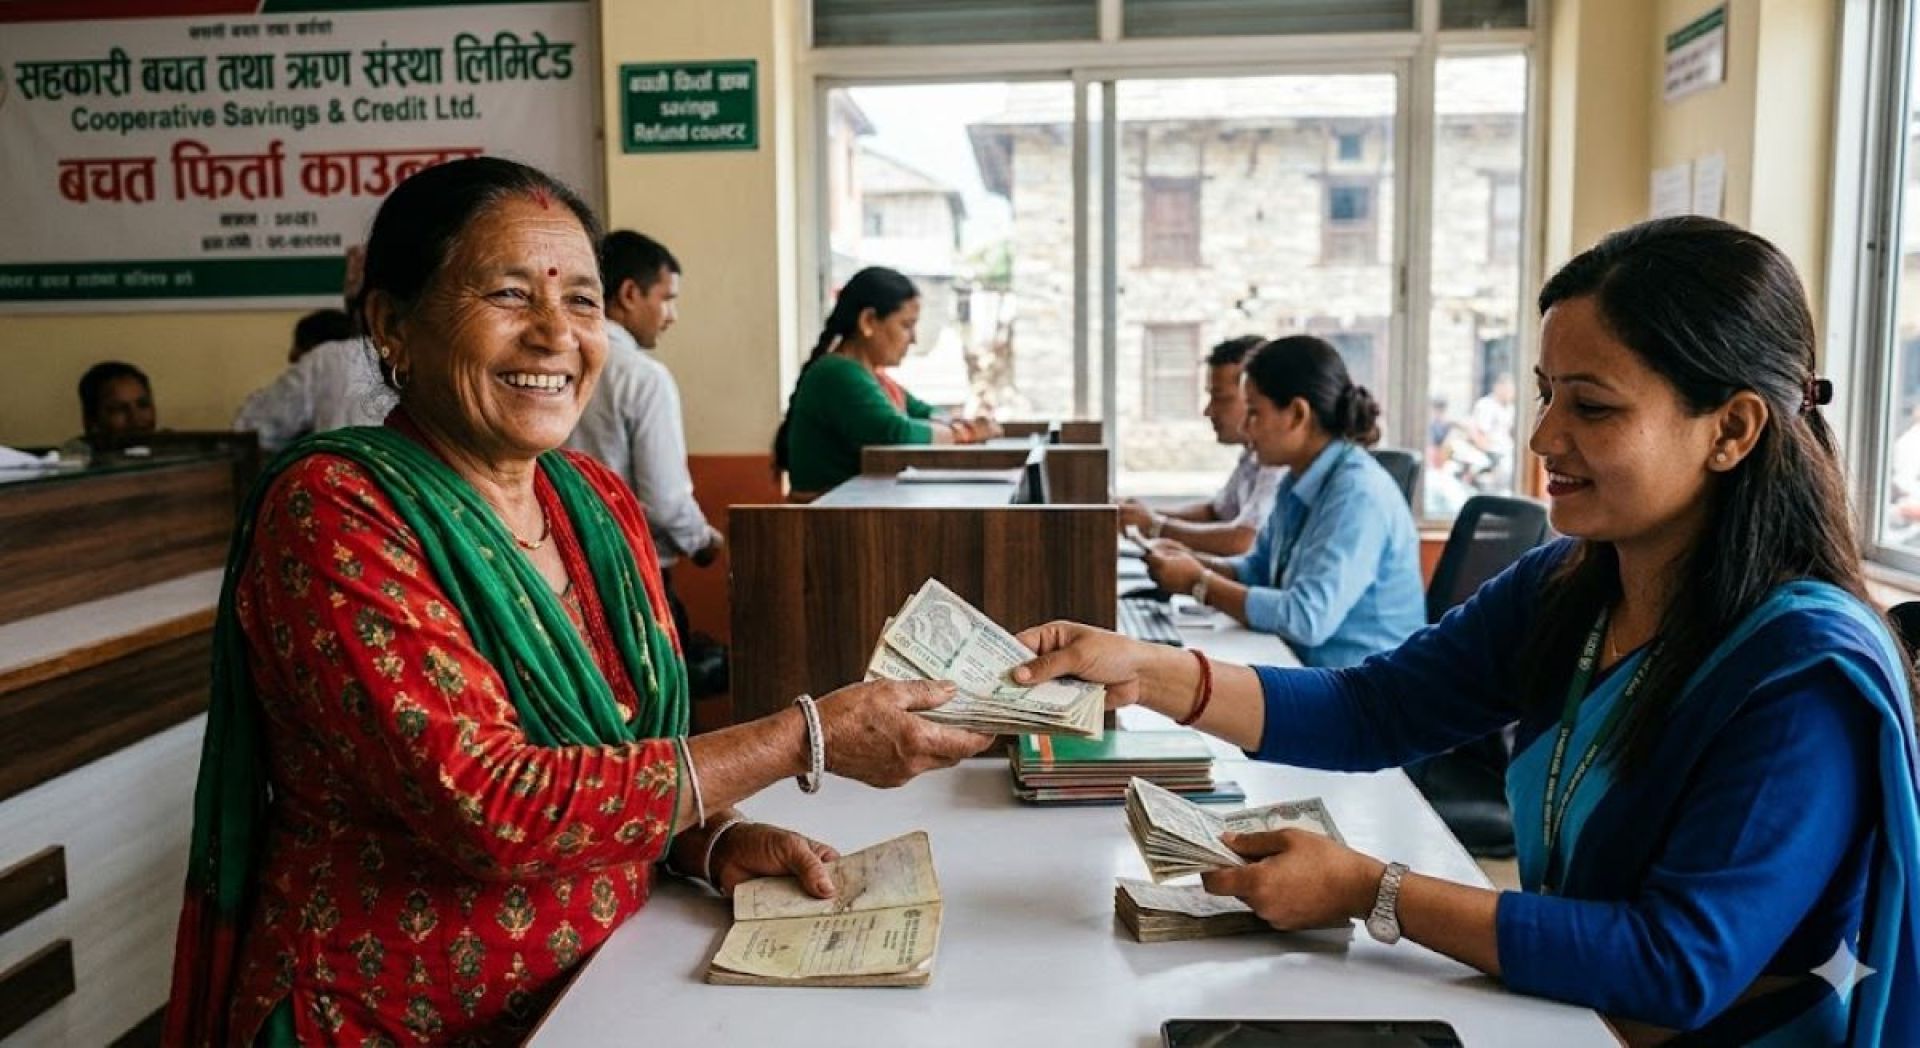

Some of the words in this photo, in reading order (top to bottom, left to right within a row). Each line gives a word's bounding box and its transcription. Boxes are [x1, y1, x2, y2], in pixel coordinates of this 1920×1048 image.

[14, 47, 131, 100] सहकारी
[141, 56, 207, 93] बचत
[216, 54, 275, 91] तथा
[284, 52, 351, 89] ऋण
[362, 40, 444, 87] संस्था
[454, 31, 576, 83] लिमिटेड
[71, 105, 216, 135] Cooperative
[223, 102, 321, 130] Savings
[327, 98, 346, 123] &
[353, 96, 428, 122] Credit
[435, 94, 482, 119] Ltd.
[58, 157, 157, 203] बचत
[171, 139, 285, 201] फिर्ता
